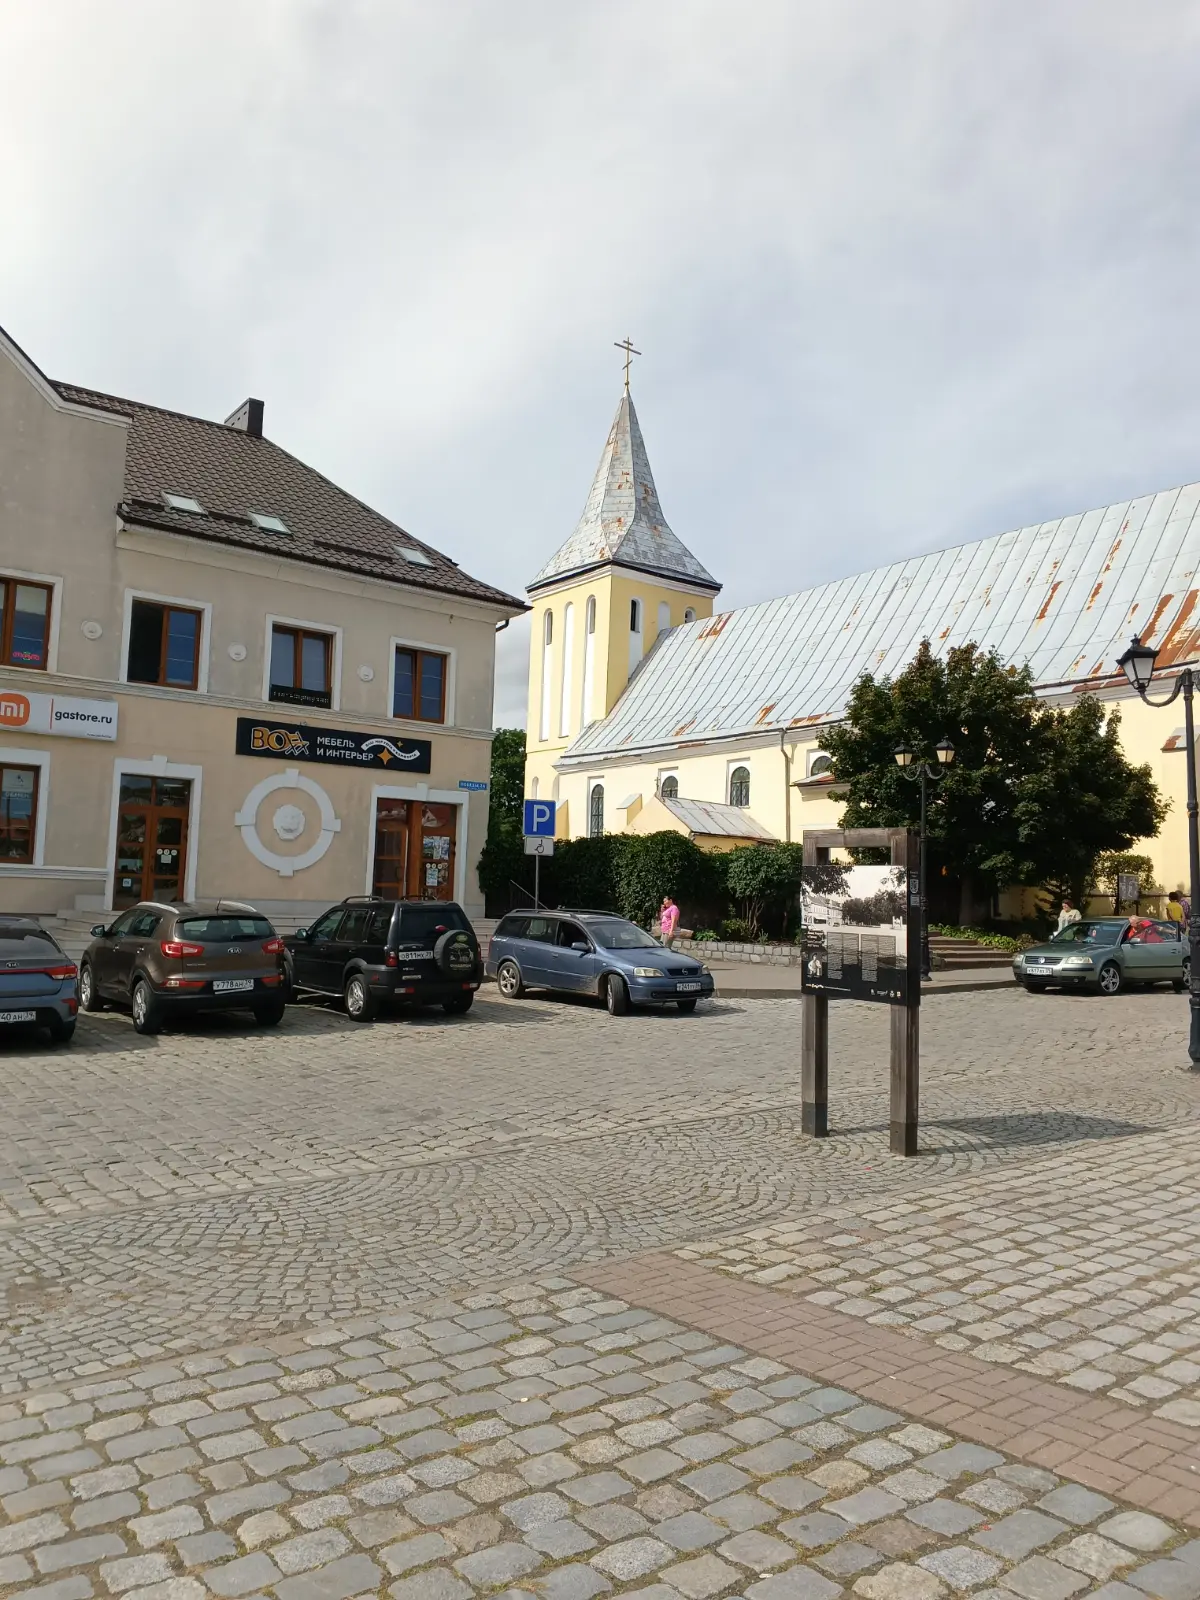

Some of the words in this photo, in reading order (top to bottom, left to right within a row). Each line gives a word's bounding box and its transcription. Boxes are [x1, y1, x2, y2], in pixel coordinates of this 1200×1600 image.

[54, 710, 113, 724] gastore.ru
[316, 736, 355, 748] МЕБЕЛЬ
[316, 747, 324, 756] И
[326, 749, 374, 761] ИНТЕРЬЕР
[532, 804, 550, 832] P
